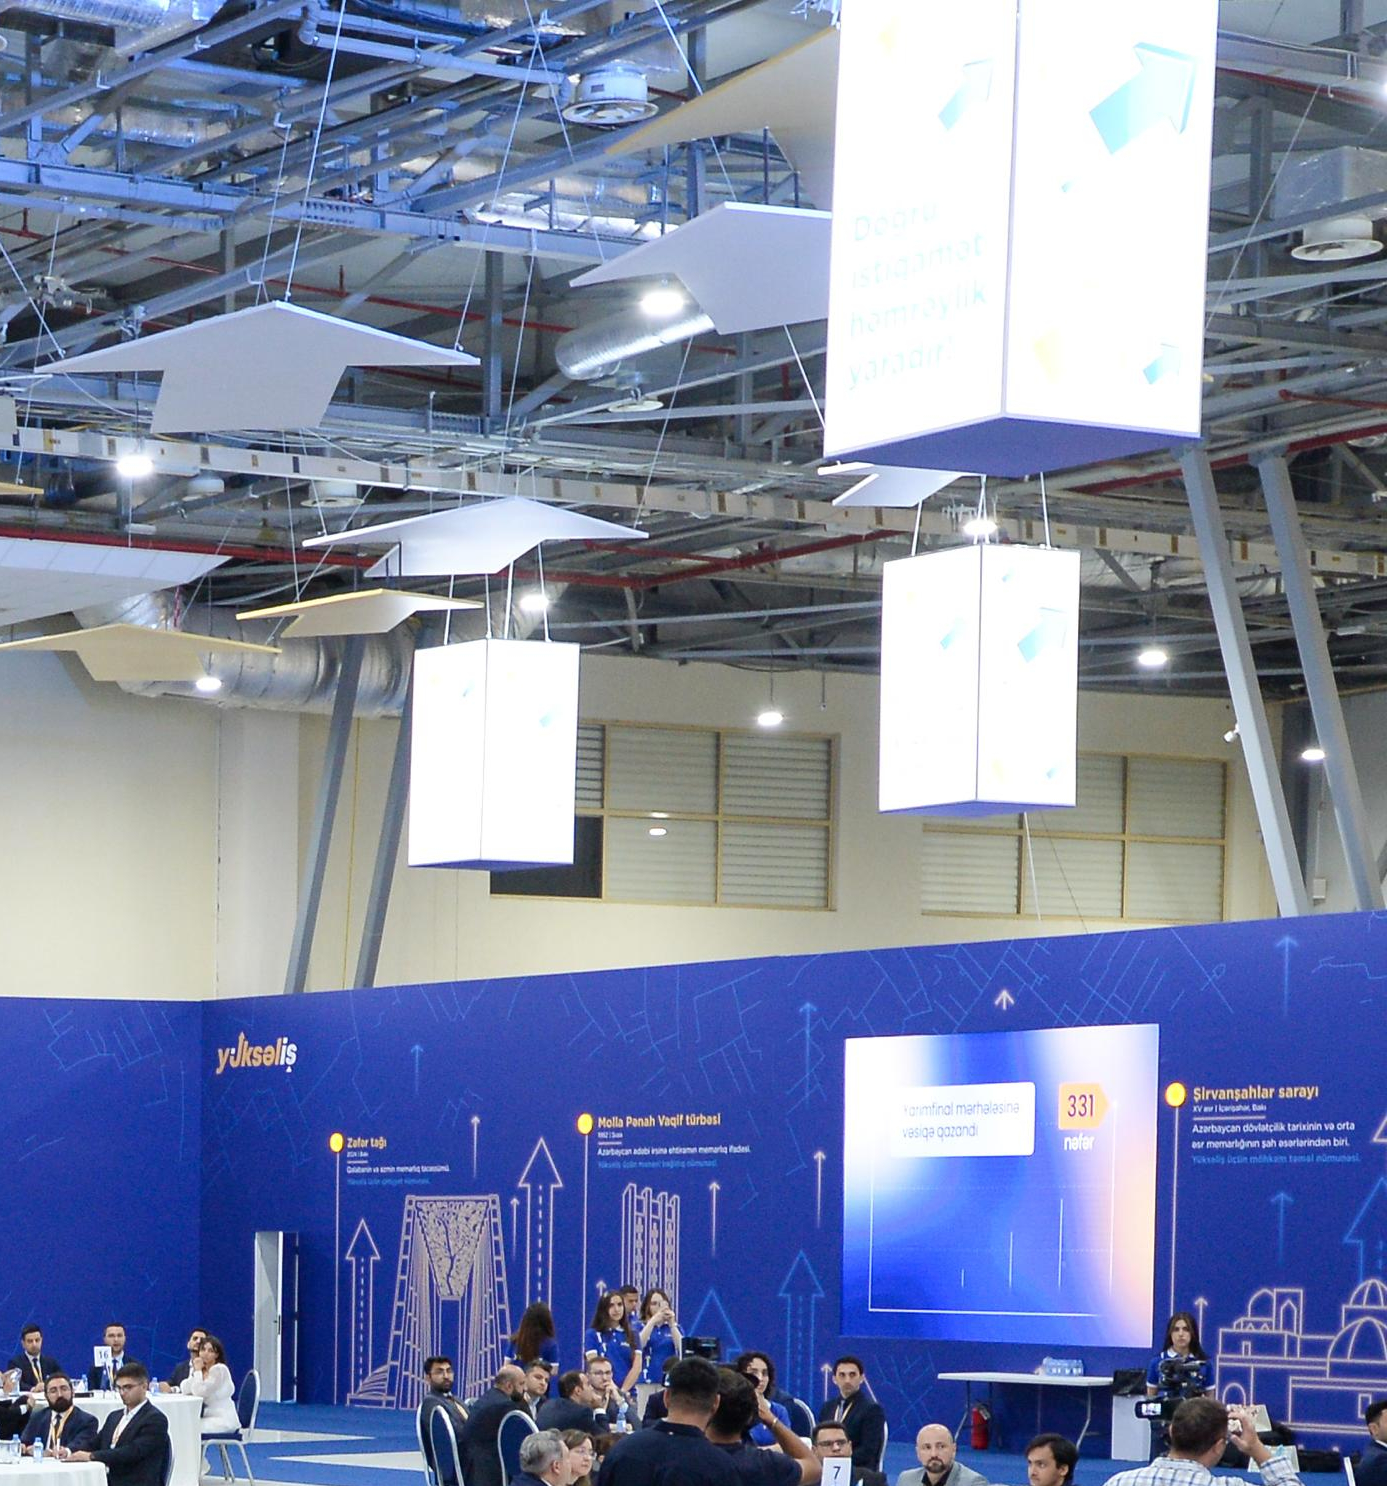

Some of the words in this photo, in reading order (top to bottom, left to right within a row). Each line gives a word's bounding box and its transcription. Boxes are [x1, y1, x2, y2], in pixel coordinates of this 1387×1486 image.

[1193, 1085, 1275, 1102] Şirvanşahlar
[1278, 1086, 1319, 1100] sarayı
[1066, 1094, 1095, 1117] 331
[833, 1465, 842, 1480] 7
